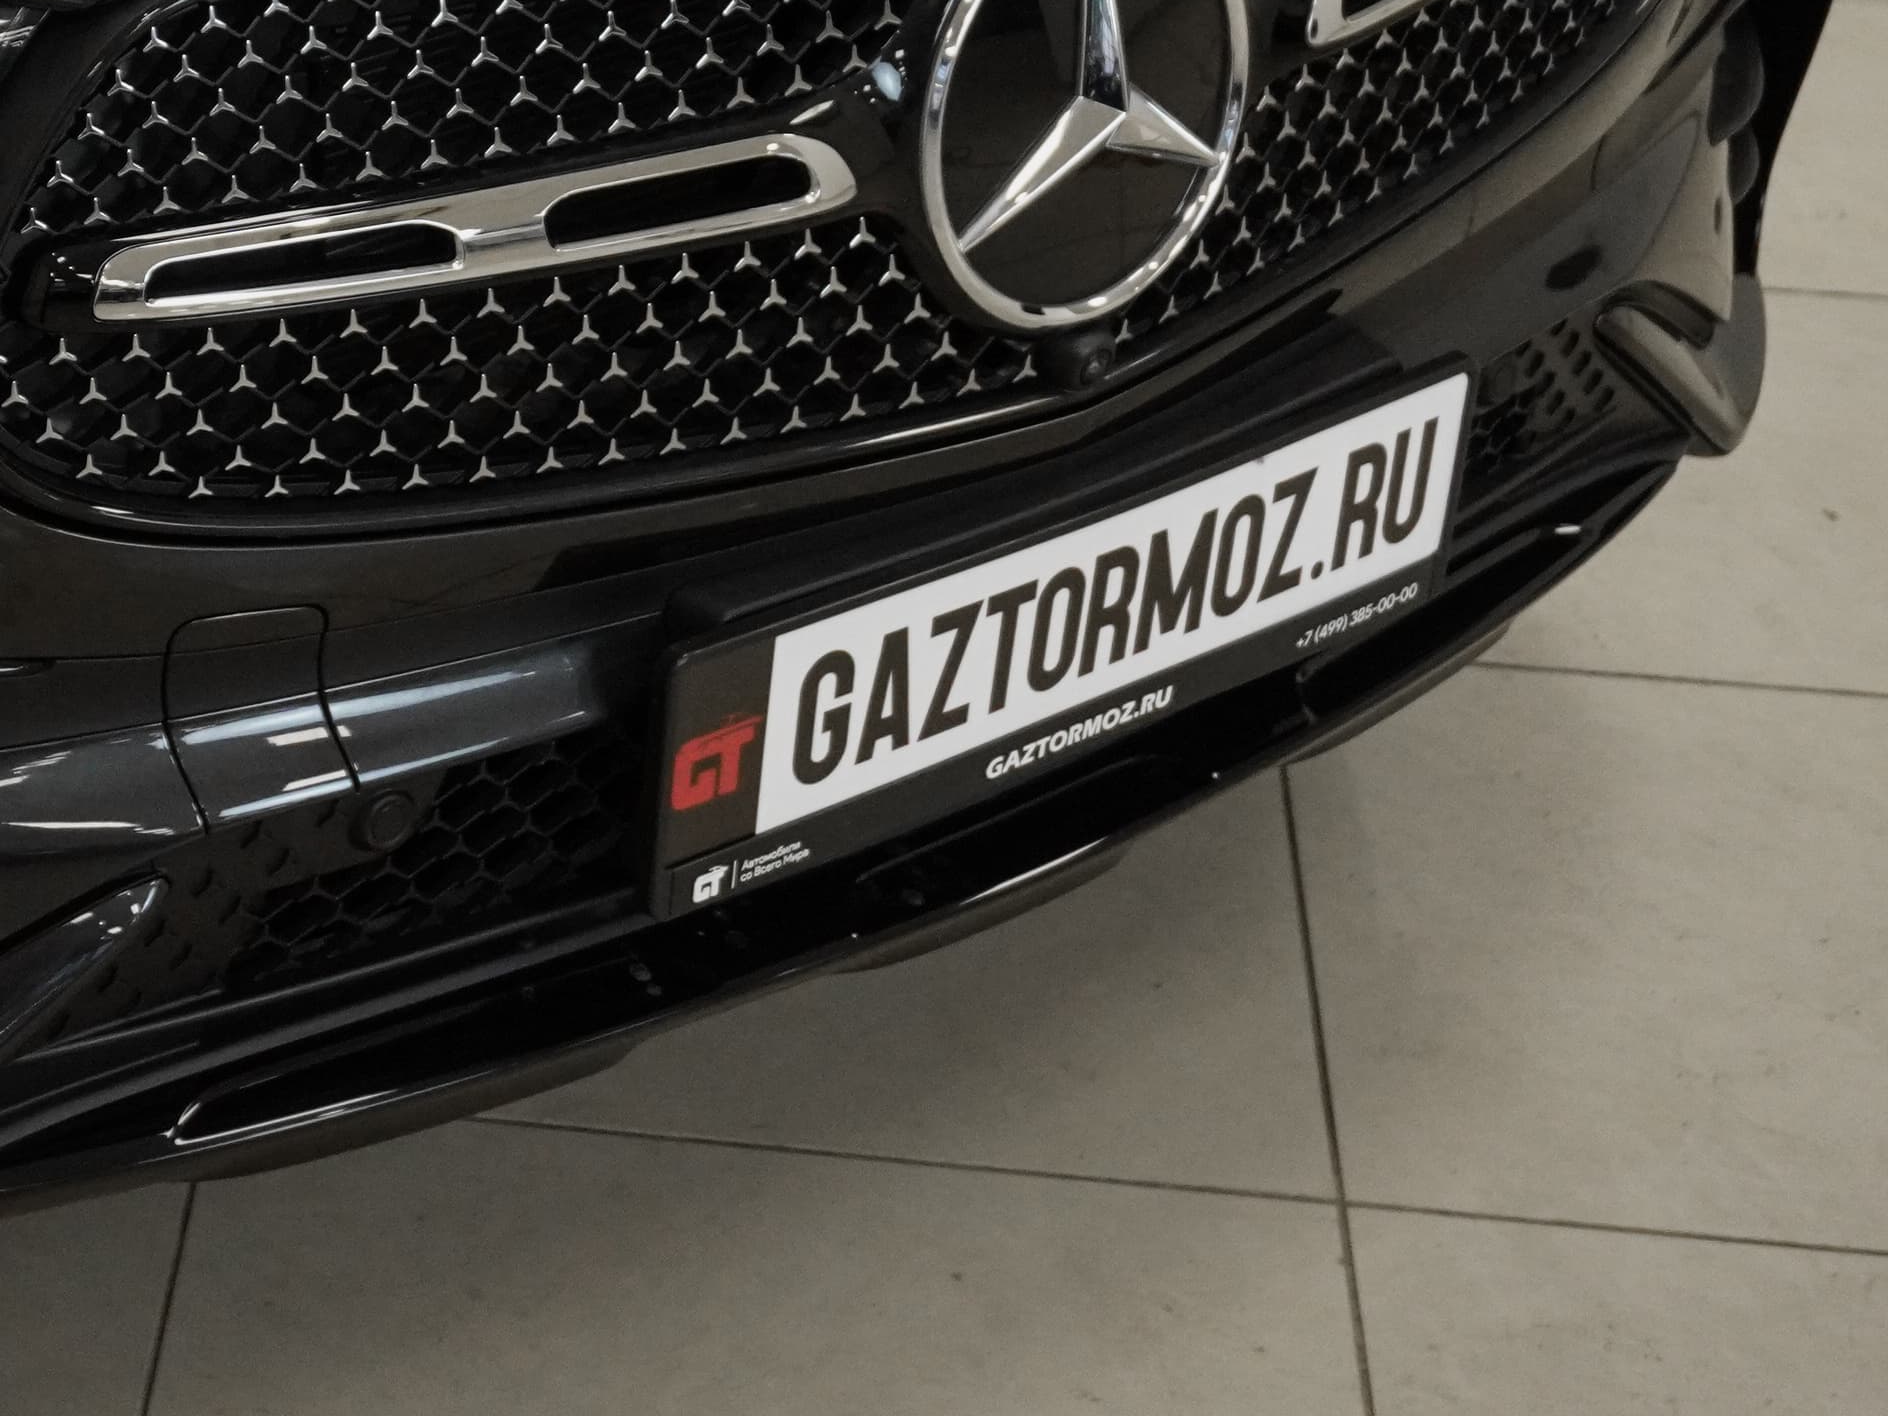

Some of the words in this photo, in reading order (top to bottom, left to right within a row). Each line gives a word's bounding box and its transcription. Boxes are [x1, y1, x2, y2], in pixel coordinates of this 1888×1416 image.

[791, 416, 1439, 785] GAZTORMOZ.RU
[1296, 630, 1314, 649] +7
[1314, 613, 1349, 643] (499)
[1349, 582, 1418, 626] 385-00-00
[671, 716, 763, 812] GT
[985, 685, 1174, 779] GAZTORMOZ.RU
[692, 865, 729, 903] GT
[740, 871, 753, 882] со
